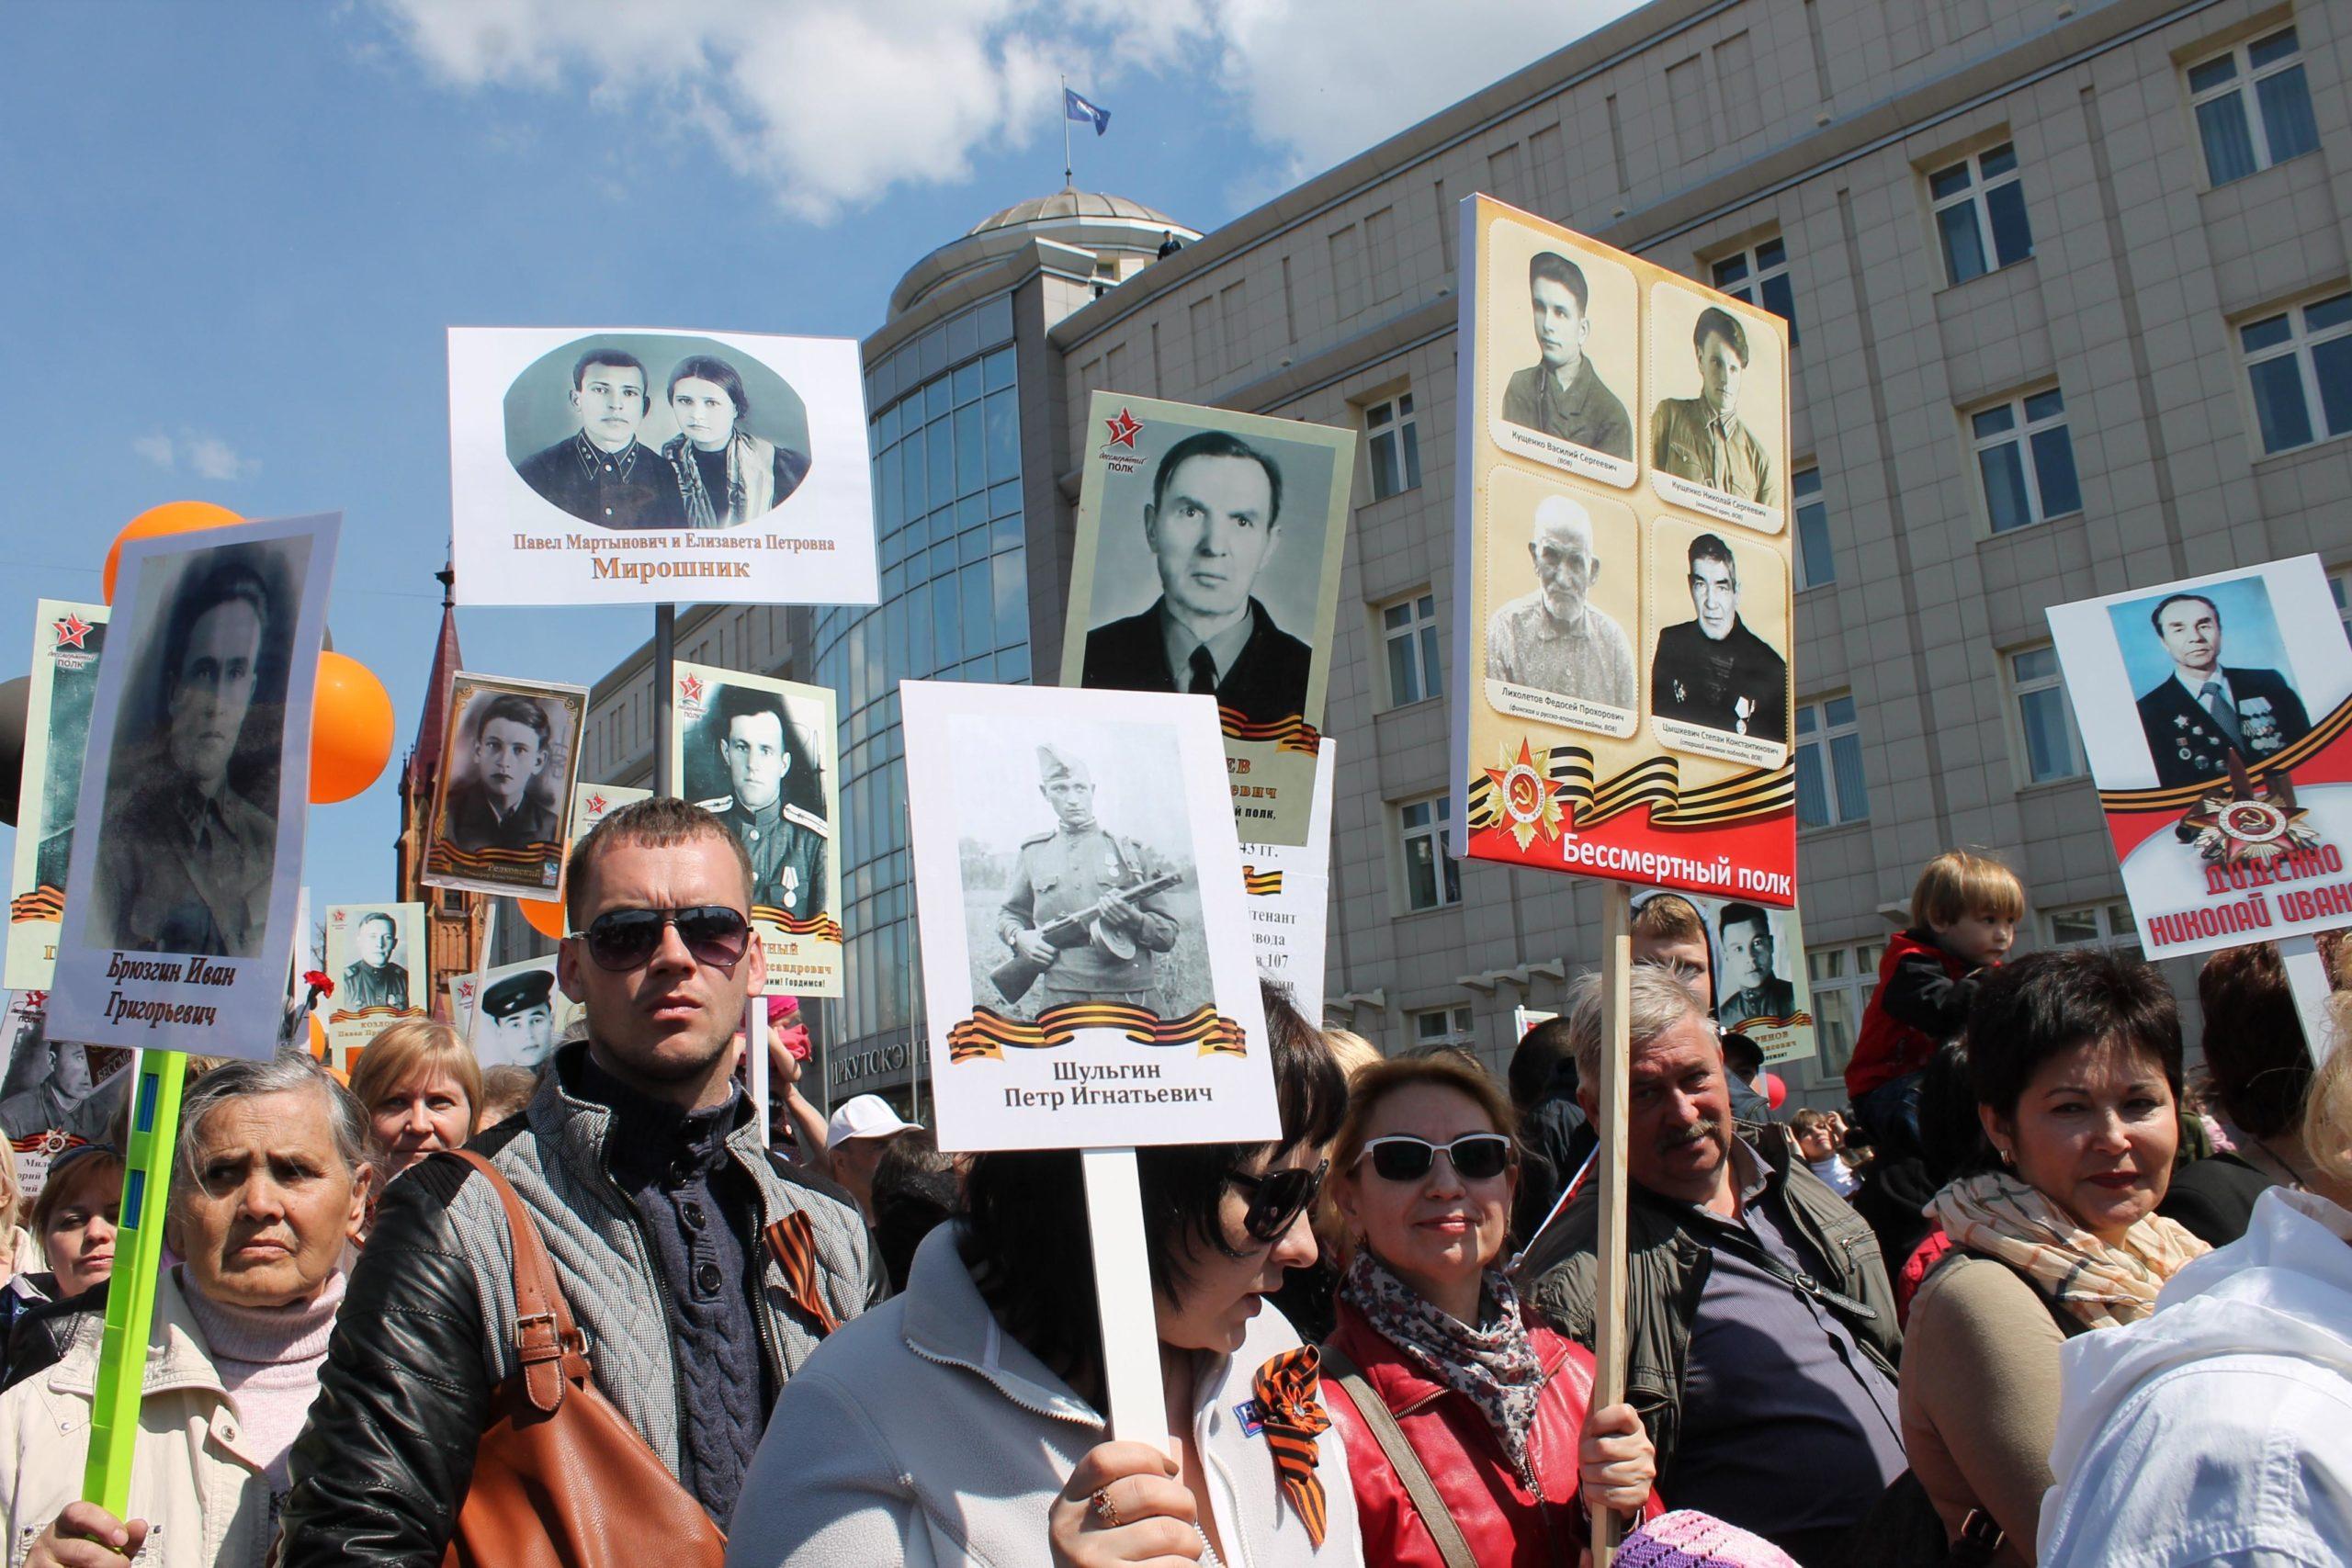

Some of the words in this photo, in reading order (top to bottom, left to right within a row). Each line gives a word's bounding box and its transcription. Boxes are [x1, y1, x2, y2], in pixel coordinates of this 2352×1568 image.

[1511, 430, 1545, 448] Кущенко
[1547, 442, 1578, 459] Василий
[1579, 453, 1617, 471] Сергеевич
[1108, 462, 1134, 473] ПОЛК
[1703, 491, 1732, 506] Николай
[1733, 501, 1766, 517] Сергеевич
[513, 534, 562, 550] Павел
[566, 534, 667, 553] Мартынович
[672, 536, 681, 548] и
[684, 532, 762, 549] Елизавета
[764, 534, 835, 553] Петровна
[591, 557, 751, 584] Мирошник
[57, 659, 84, 668] ПОЛК
[1501, 687, 1544, 704] Лихолетов
[1544, 696, 1577, 712] Федосей
[1579, 705, 1624, 722] Прохорович
[1662, 722, 1700, 739] Цышкевич
[1701, 731, 1724, 743] Степан
[1725, 738, 1779, 755] Константинович
[1226, 757, 1250, 774] ЕВ
[1231, 784, 1277, 799] евич
[1563, 833, 1731, 886] Бессмертный
[1738, 868, 1792, 897] полк
[2206, 844, 2343, 896] ДИДЕНКО
[1249, 907, 1297, 925] тенант
[2148, 892, 2272, 947] НИКОЛАЙ
[107, 952, 182, 986] Брюзгин
[184, 956, 236, 987] Иван
[766, 962, 831, 976] ксандрович
[1268, 953, 1289, 969] 107
[785, 977, 826, 988] Гордимся!
[104, 991, 217, 1029] Григорьевич
[831, 1038, 930, 1085] ИРКУТСКЭНЕ
[1054, 1062, 1161, 1084] Шульгин
[1004, 1088, 1065, 1111] Петр
[1071, 1086, 1214, 1106] Игнатьевич
